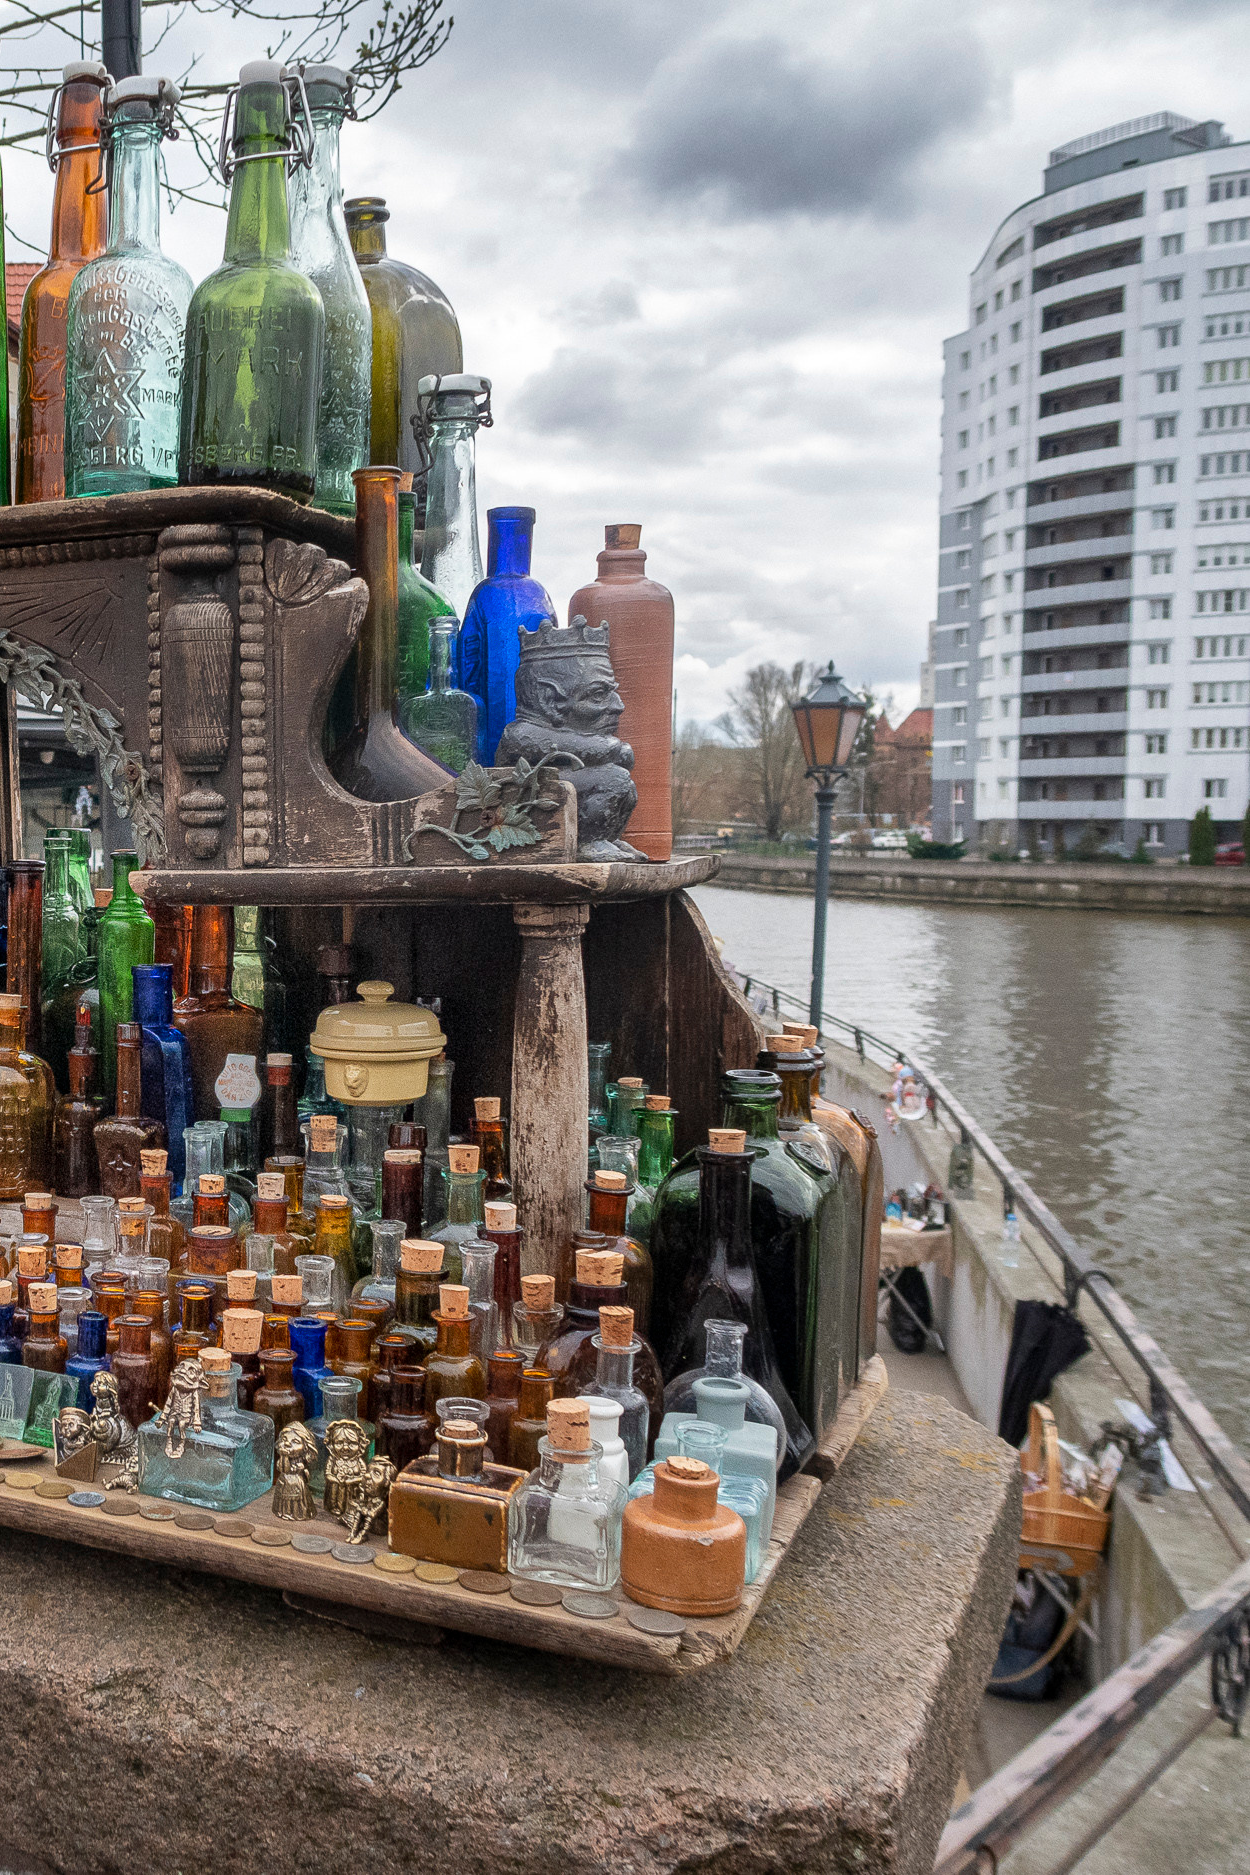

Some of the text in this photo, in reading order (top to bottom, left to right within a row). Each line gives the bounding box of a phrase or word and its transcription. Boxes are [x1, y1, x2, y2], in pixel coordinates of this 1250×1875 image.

[195, 305, 292, 334] AUEREI
[191, 345, 304, 380] TMARK
[141, 386, 184, 408] MARK
[191, 443, 263, 465] SBERG
